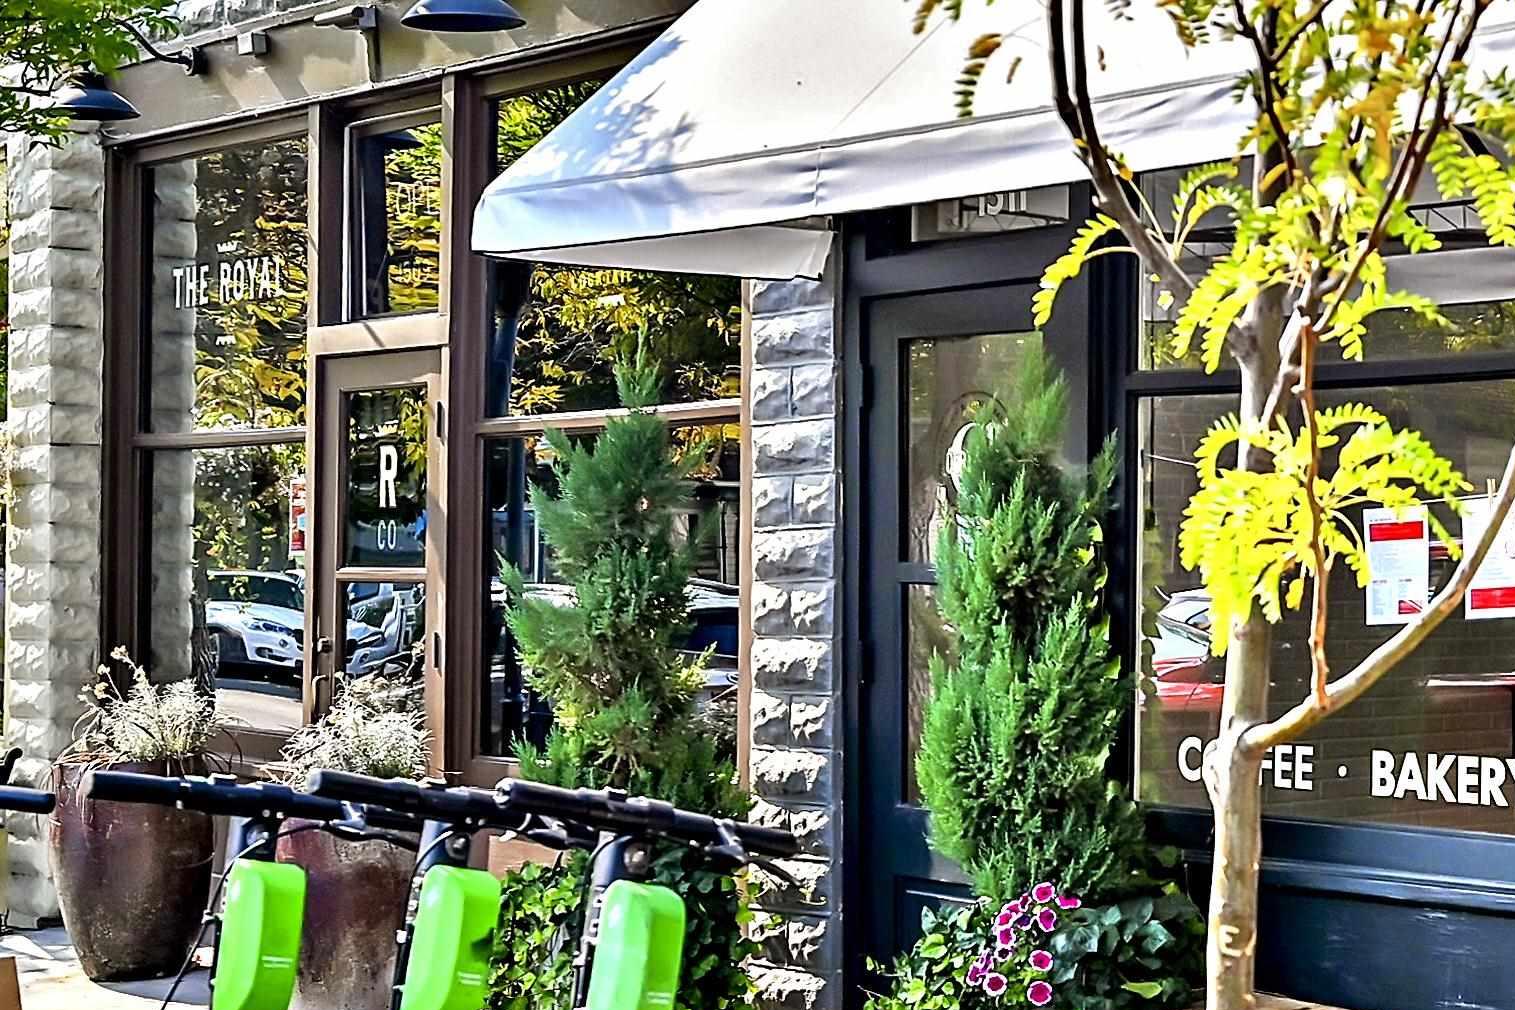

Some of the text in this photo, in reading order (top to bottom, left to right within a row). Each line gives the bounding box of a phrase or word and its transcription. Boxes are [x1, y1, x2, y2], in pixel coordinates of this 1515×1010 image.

[173, 256, 285, 309] THE ROYAL
[379, 445, 398, 508] R
[377, 519, 398, 550] CO
[1177, 736, 1314, 792] CFEE
